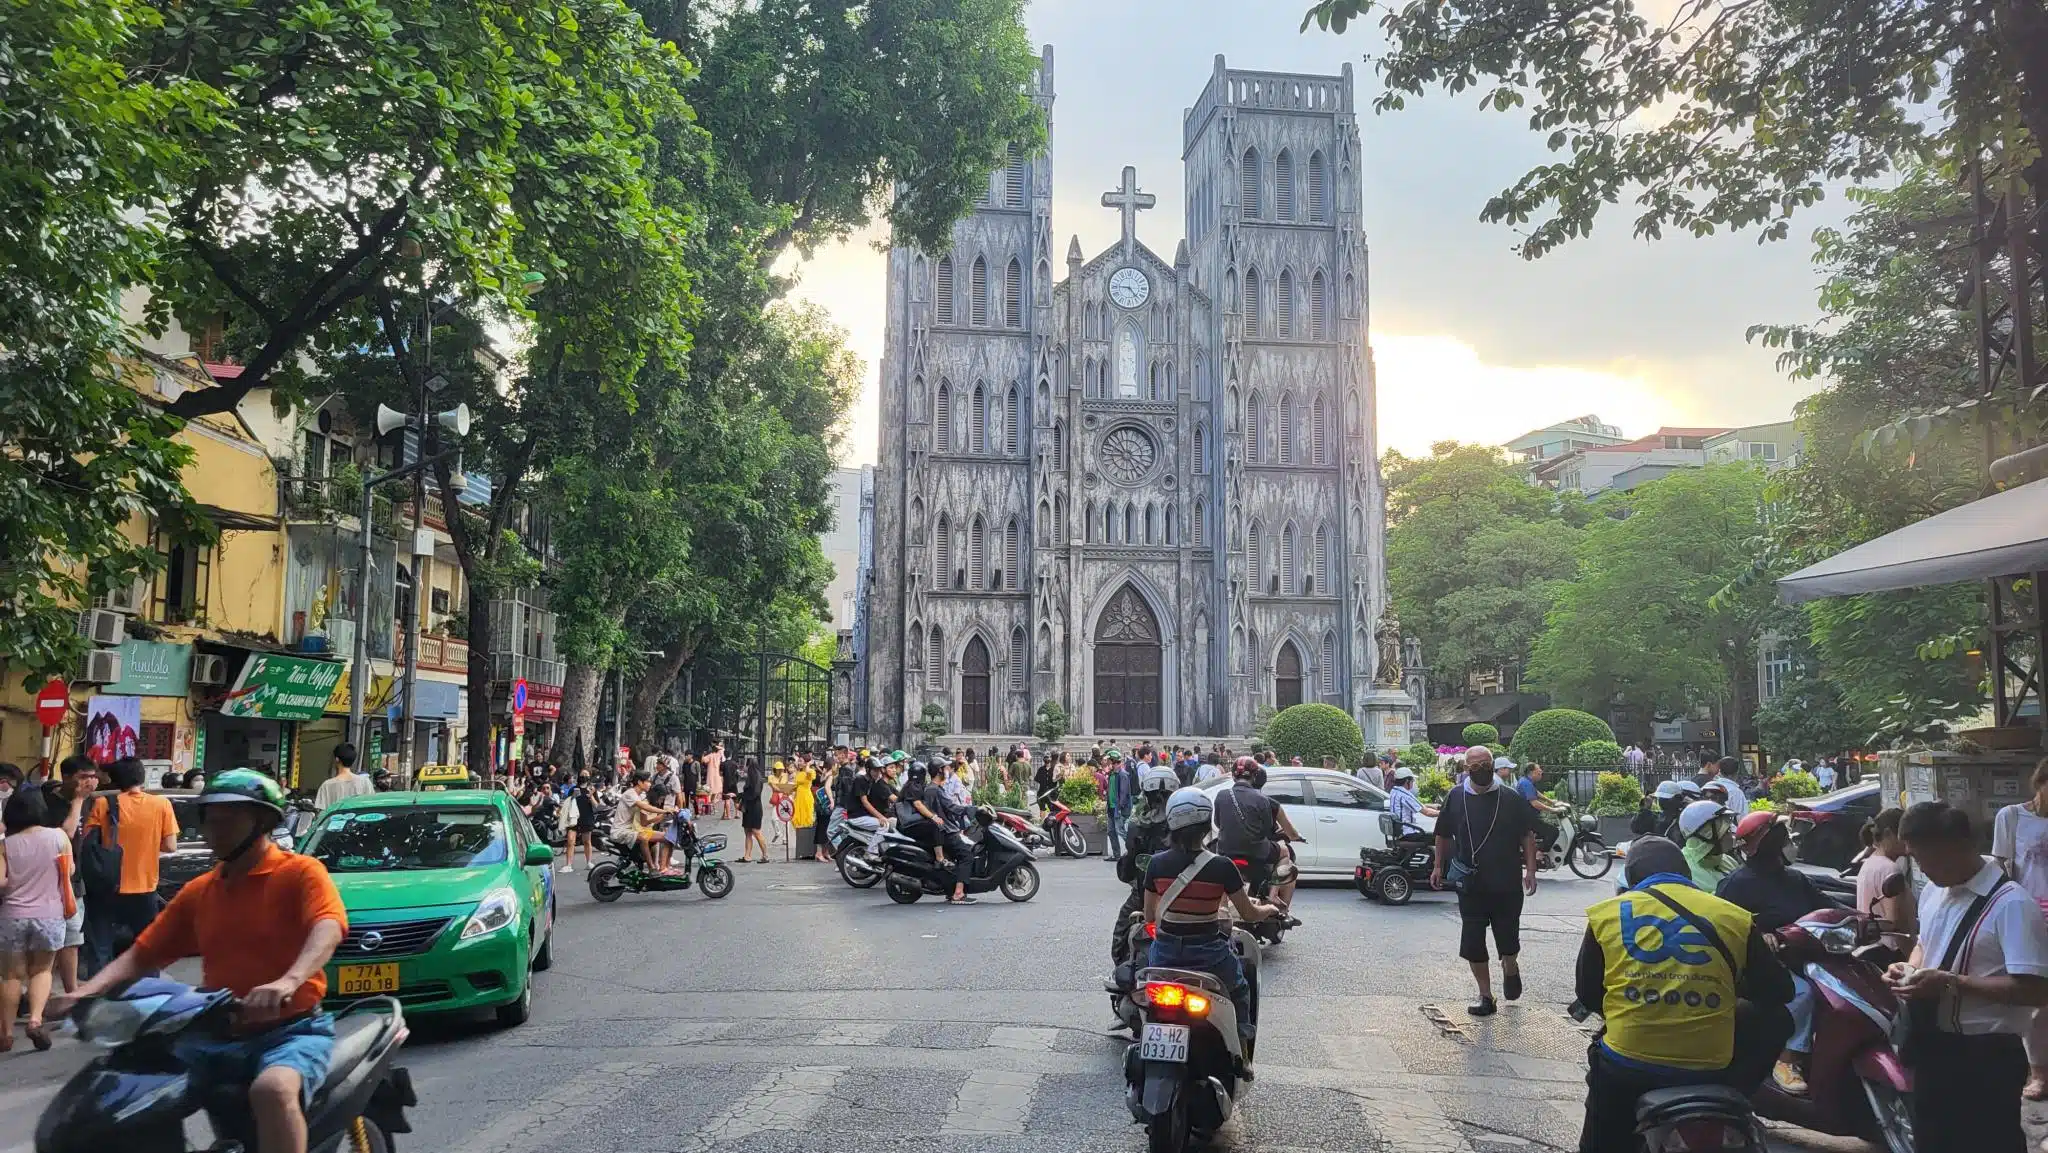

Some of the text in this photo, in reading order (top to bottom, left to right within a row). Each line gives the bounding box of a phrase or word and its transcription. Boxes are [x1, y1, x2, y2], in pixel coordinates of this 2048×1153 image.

[426, 767, 460, 776] TAXI
[1620, 900, 1713, 966] be
[356, 965, 382, 978] 77A
[1149, 1026, 1183, 1043] 29-H2
[1143, 1043, 1185, 1060] 033.70
